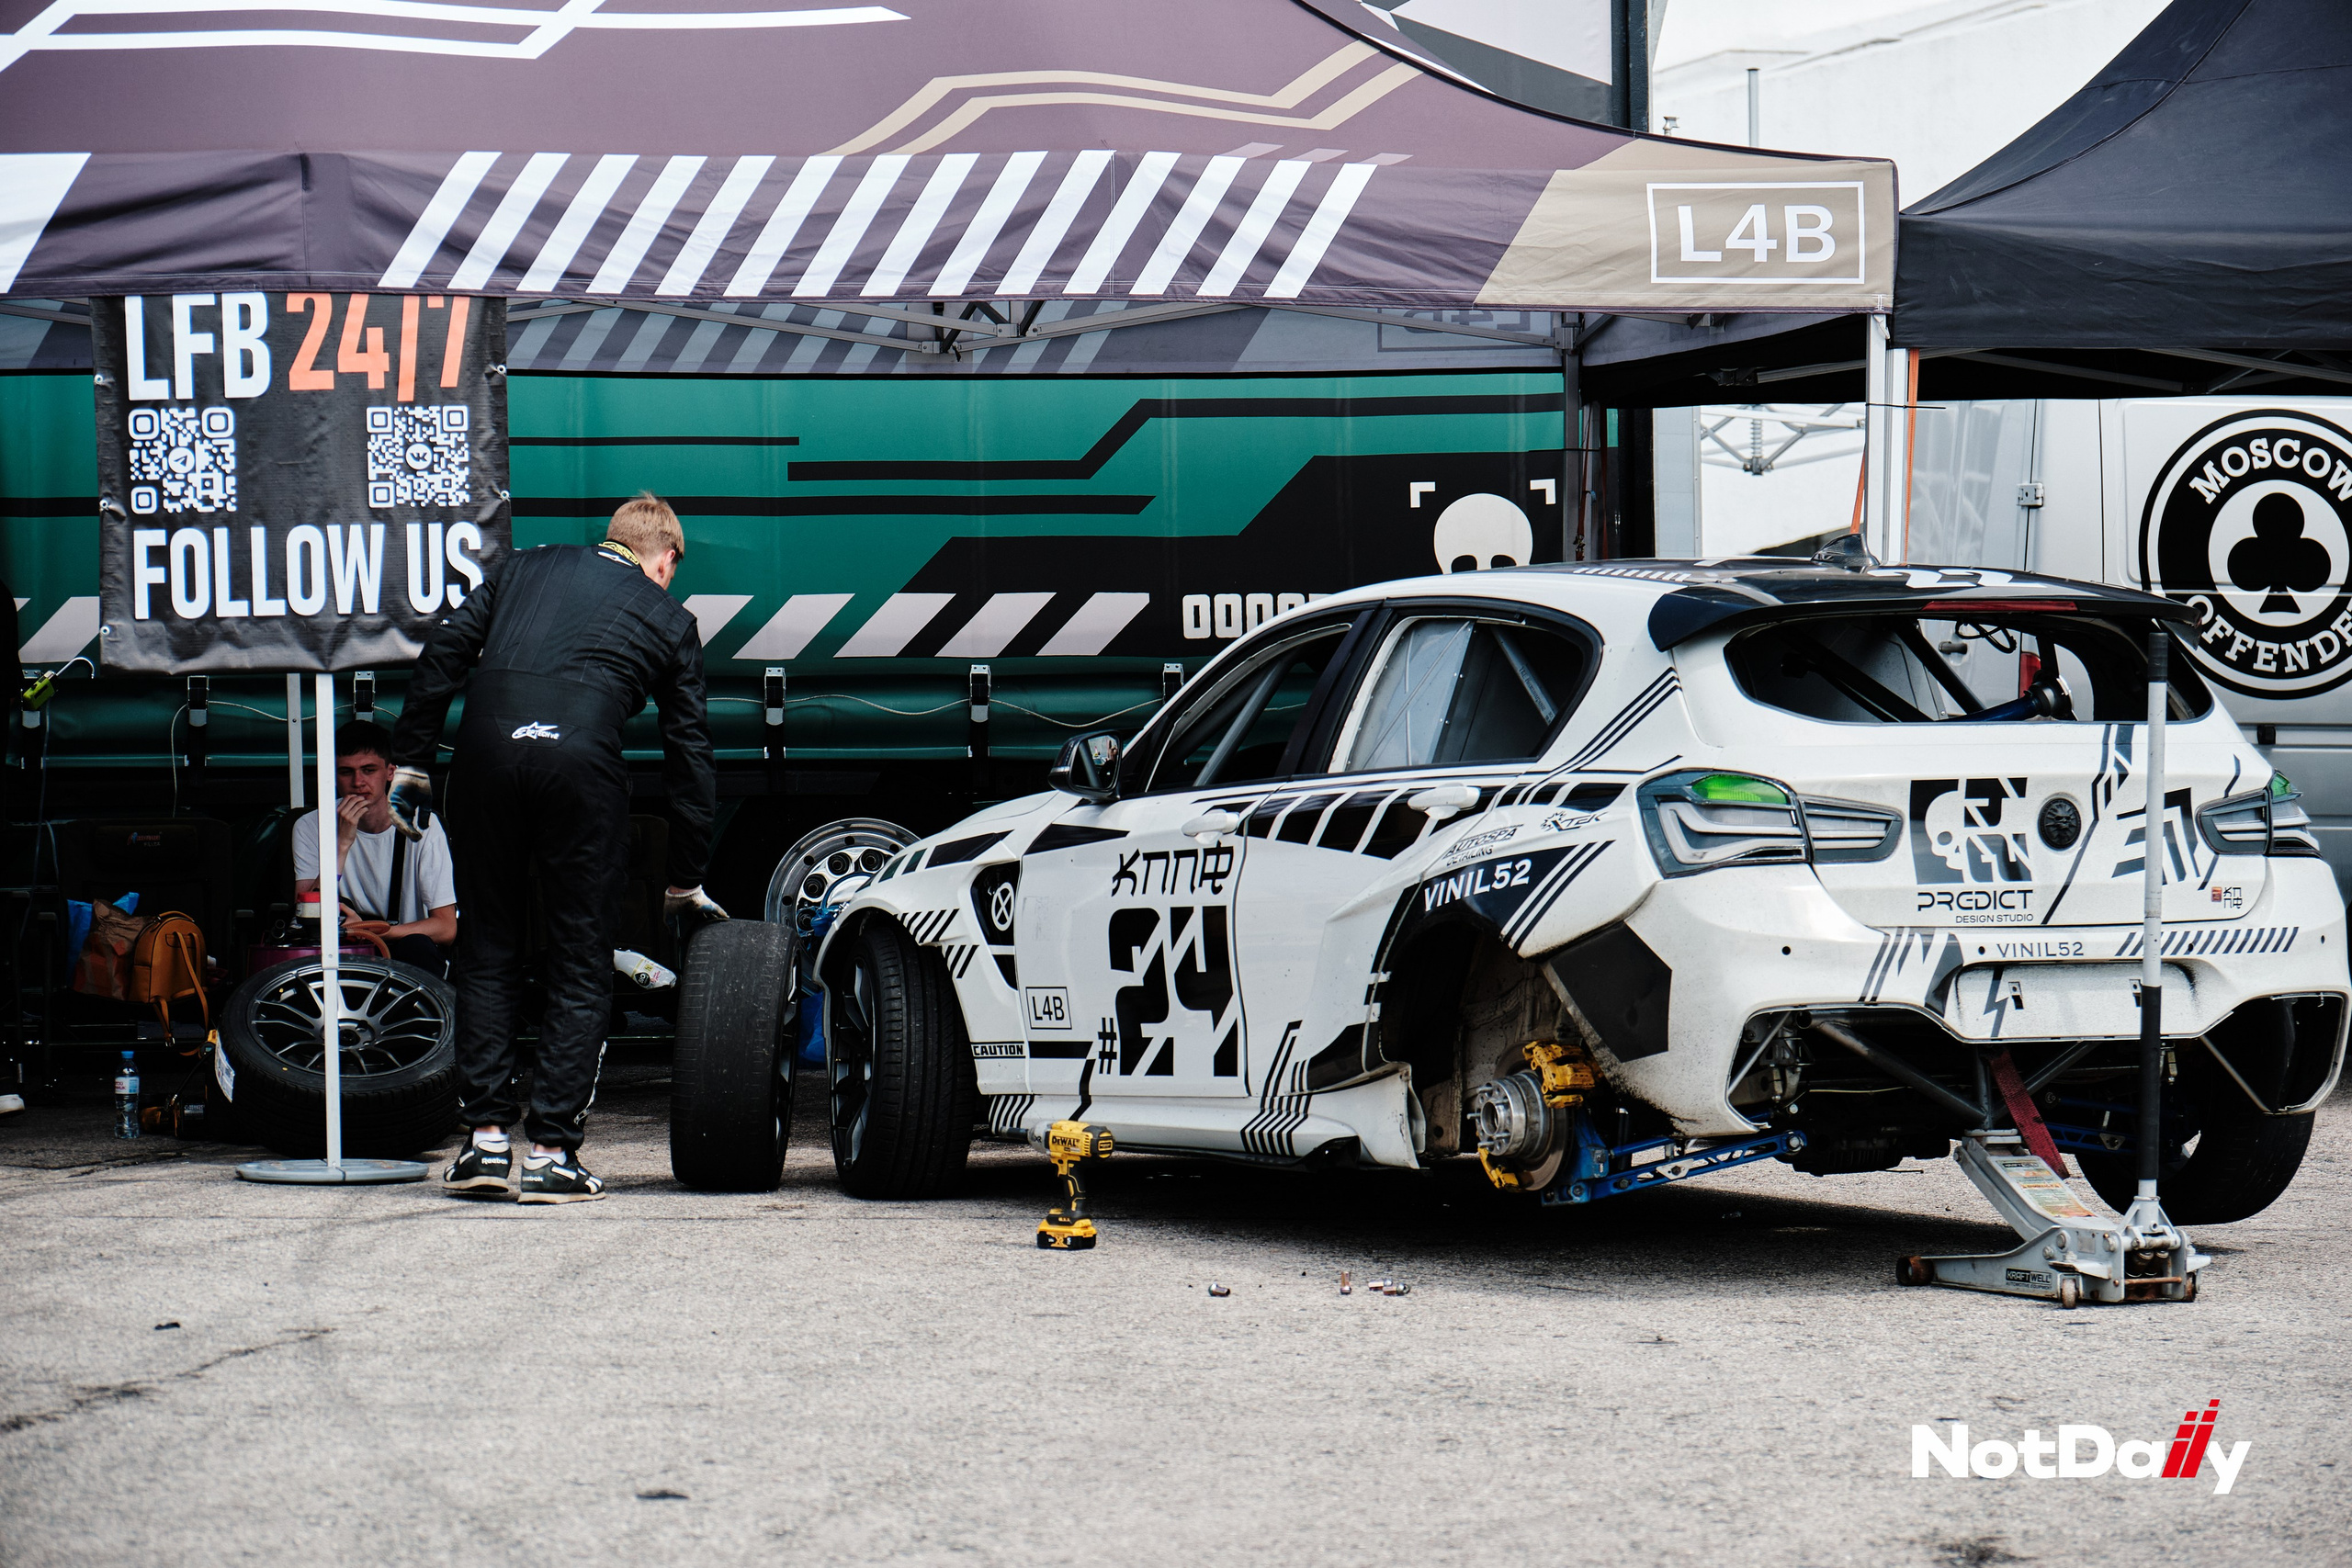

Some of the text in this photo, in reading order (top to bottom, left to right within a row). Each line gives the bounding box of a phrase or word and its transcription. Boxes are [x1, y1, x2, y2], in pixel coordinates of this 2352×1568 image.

[1678, 204, 1836, 263] L4B
[125, 292, 469, 401] LFB 24/7
[2189, 438, 2352, 504] MOSCOW
[133, 522, 483, 619] FOLLOW US
[2187, 595, 2352, 672] OFFENDE
[1424, 859, 1532, 912] VINIL52
[1917, 889, 2033, 911] PREDICT
[1955, 913, 2033, 923] DESIGN STUDIO
[1996, 942, 2084, 957] VINIL52
[1032, 996, 1065, 1021] L4B
[973, 1044, 1023, 1055] CAUTION
